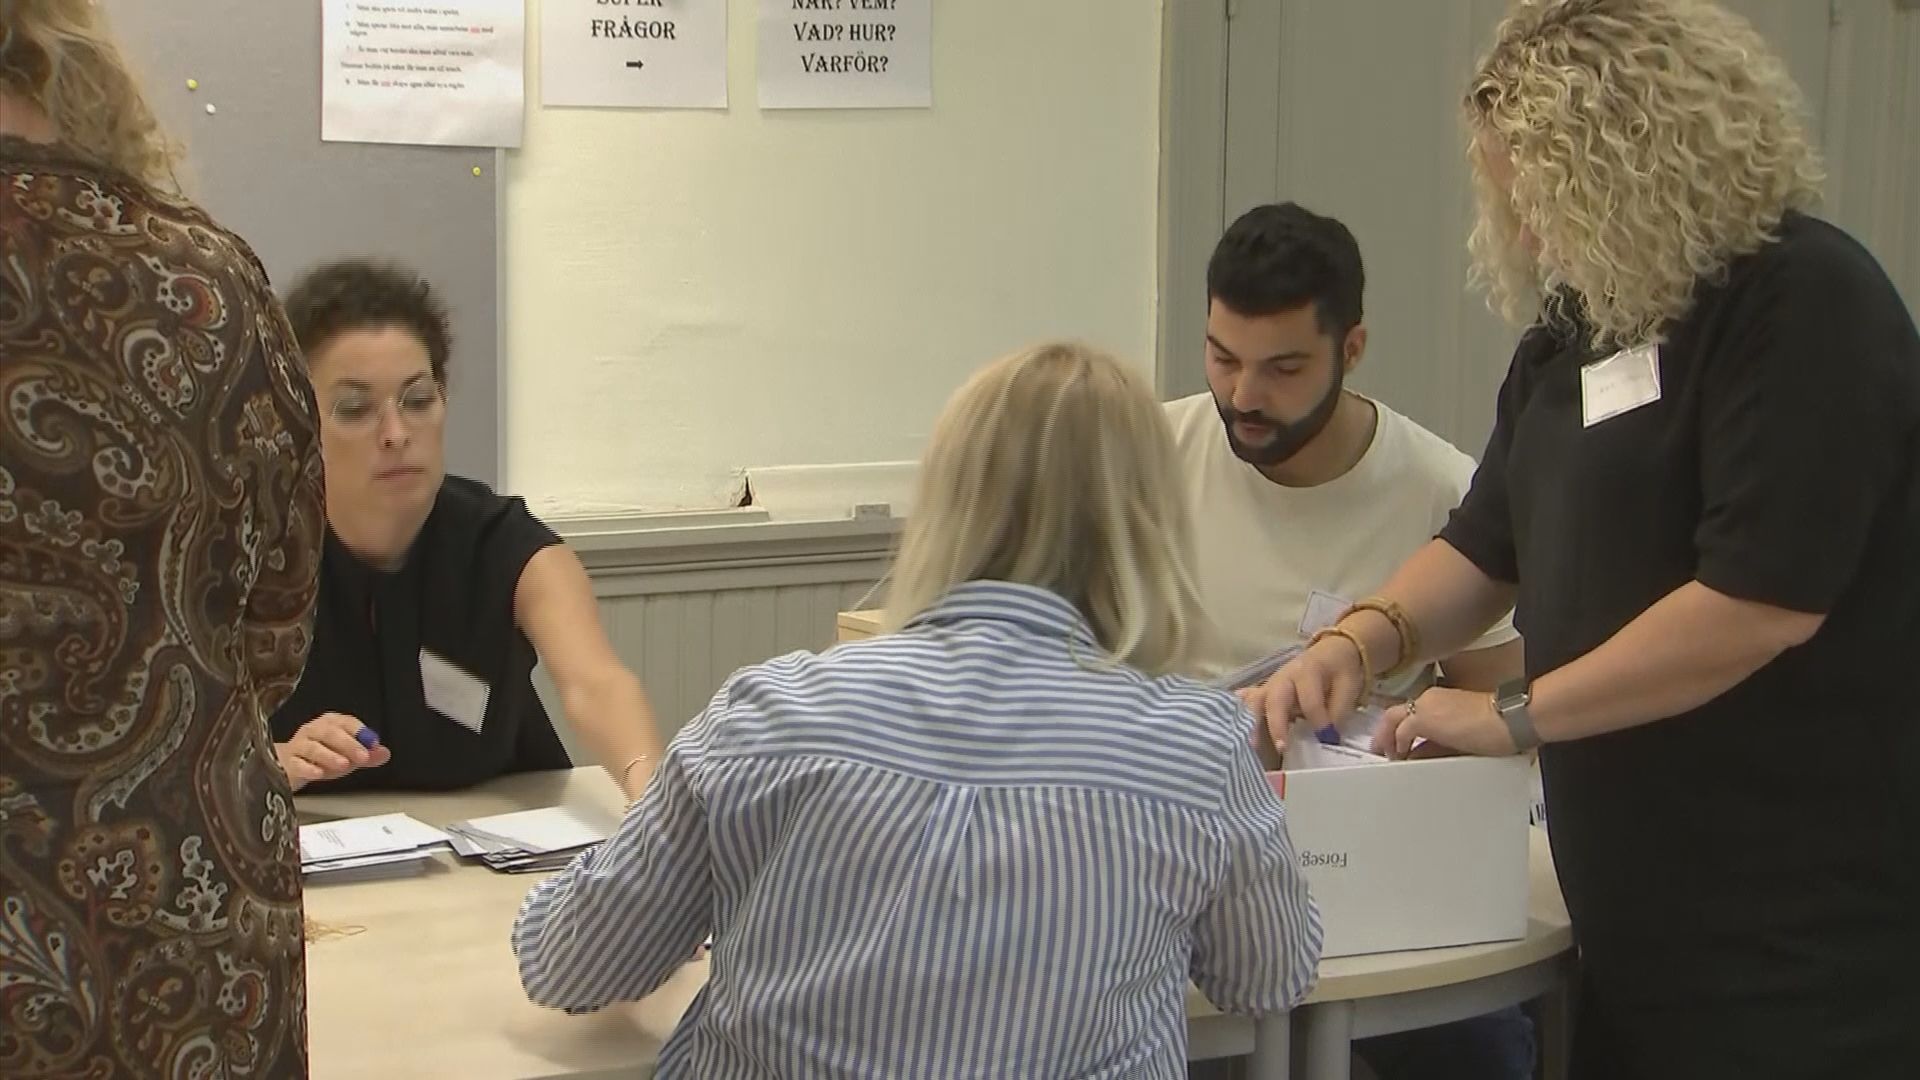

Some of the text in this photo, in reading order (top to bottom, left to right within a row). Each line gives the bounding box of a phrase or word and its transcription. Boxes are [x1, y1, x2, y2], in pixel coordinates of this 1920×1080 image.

[591, 15, 676, 40] FRÅGOR
[793, 21, 896, 42] VAD? HUR?
[801, 51, 889, 73] VARFÖR?
[1298, 851, 1348, 868] Förseg
